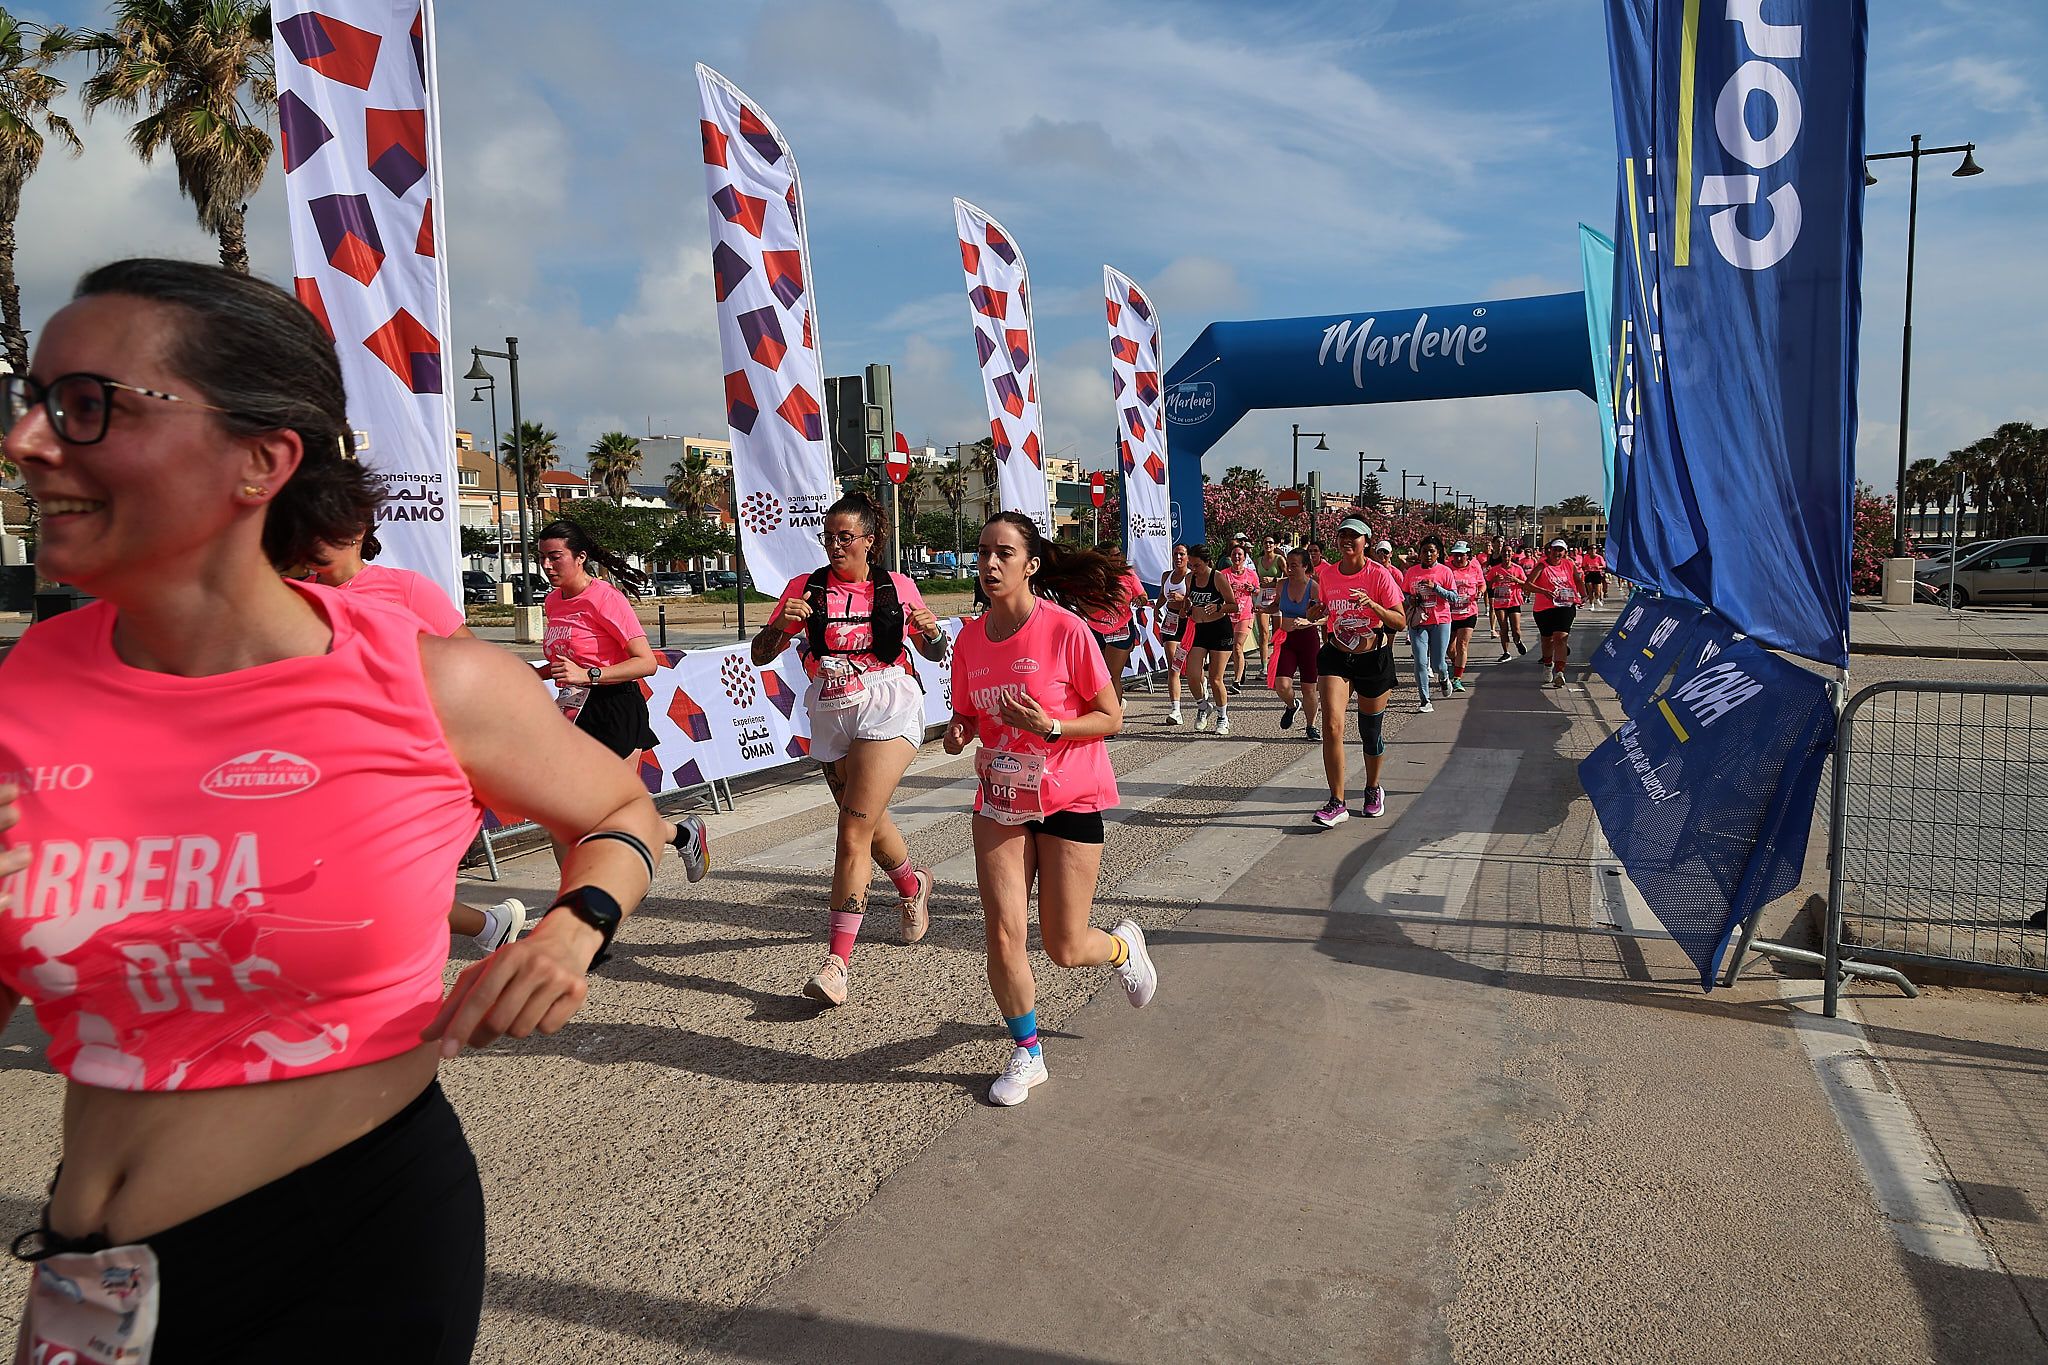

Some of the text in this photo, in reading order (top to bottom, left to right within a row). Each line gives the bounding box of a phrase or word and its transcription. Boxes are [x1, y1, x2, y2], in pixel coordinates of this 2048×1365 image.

[1318, 313, 1487, 389] Marlene
[1166, 392, 1211, 414] Marlene
[544, 626, 572, 640] ARRERA
[1671, 662, 1764, 727] GOYA
[733, 715, 765, 728] Experience
[741, 742, 774, 760] OMAN
[1615, 747, 1645, 765] que
[1633, 758, 1652, 773] ser
[208, 769, 310, 788] ASTURIANA
[1641, 762, 1681, 804] bueno!
[992, 784, 1017, 799] 016
[0, 832, 264, 919] ARRERA
[114, 939, 225, 1014] DE
